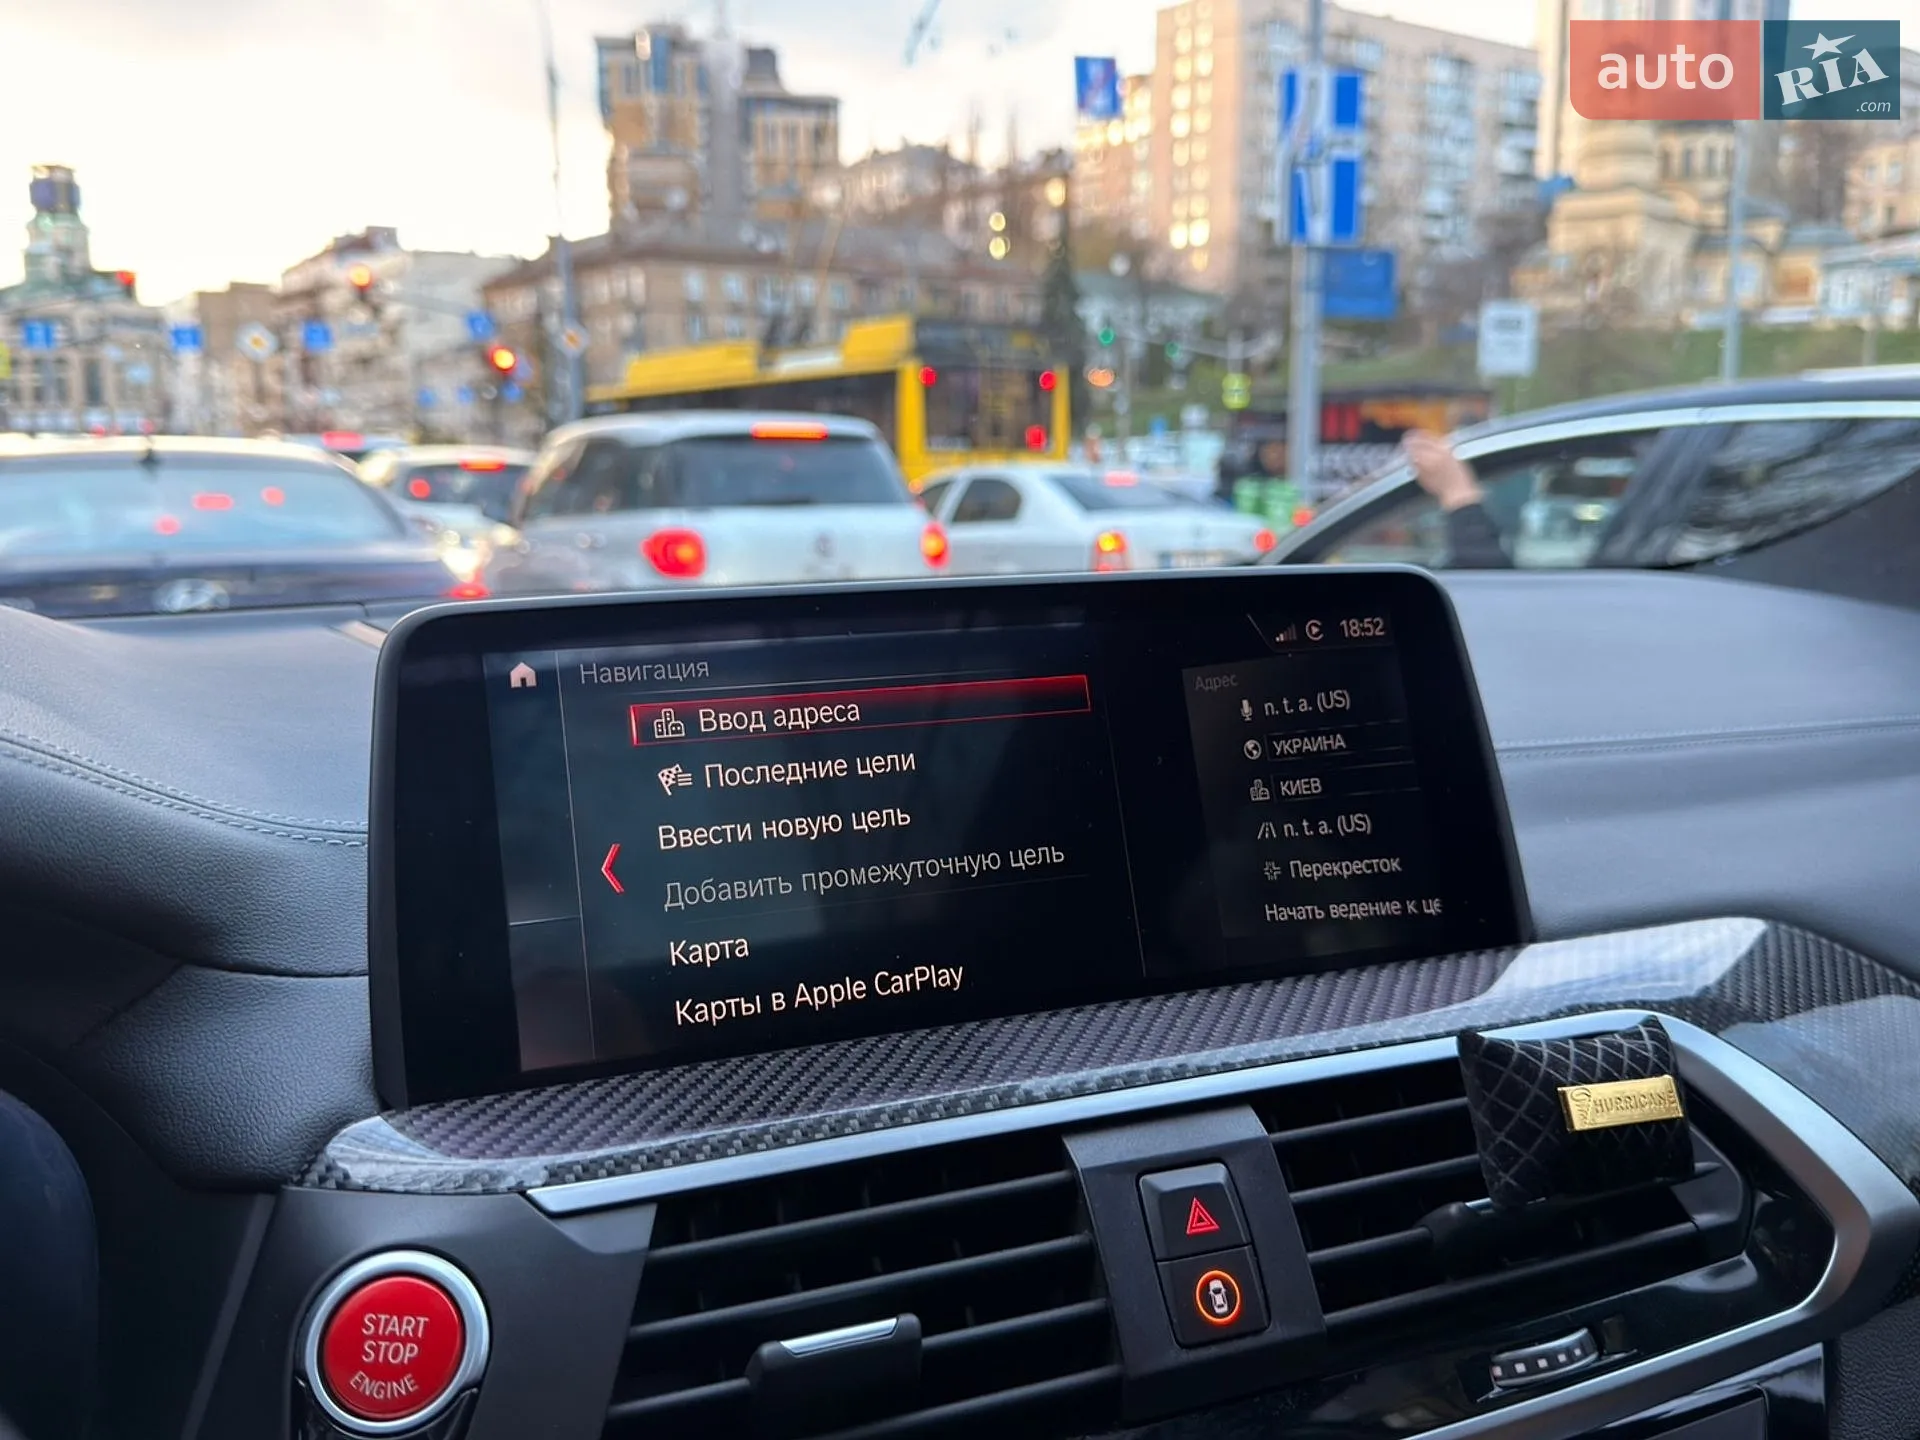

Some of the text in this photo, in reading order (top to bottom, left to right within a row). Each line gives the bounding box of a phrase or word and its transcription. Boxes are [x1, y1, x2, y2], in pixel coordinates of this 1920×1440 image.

[1340, 617, 1385, 638] 18:52
[580, 661, 710, 685] Навигация
[1194, 673, 1238, 692] Адрес
[1264, 689, 1351, 716] n. t. a. (US)
[699, 703, 860, 733] Ввод адреса
[1273, 733, 1346, 756] УКРАИНА
[704, 753, 916, 789] Последние цели
[1280, 777, 1322, 797] КИЕВ
[658, 807, 911, 850] Ввести новую цель
[1284, 813, 1372, 838] n. t. a. (US)
[664, 844, 1066, 912] Добавить промежуточную цель
[1289, 857, 1402, 881] Перекресток
[1265, 904, 1325, 922] Начать
[1329, 900, 1401, 920] ведение
[1406, 900, 1419, 914] к
[669, 936, 750, 968] Карта
[675, 964, 964, 1026] Карты в Apple CarPlay
[1593, 1088, 1676, 1114] HURRICANE
[361, 1313, 429, 1338] START
[361, 1341, 419, 1365] STOP
[349, 1370, 419, 1400] ENGINE
